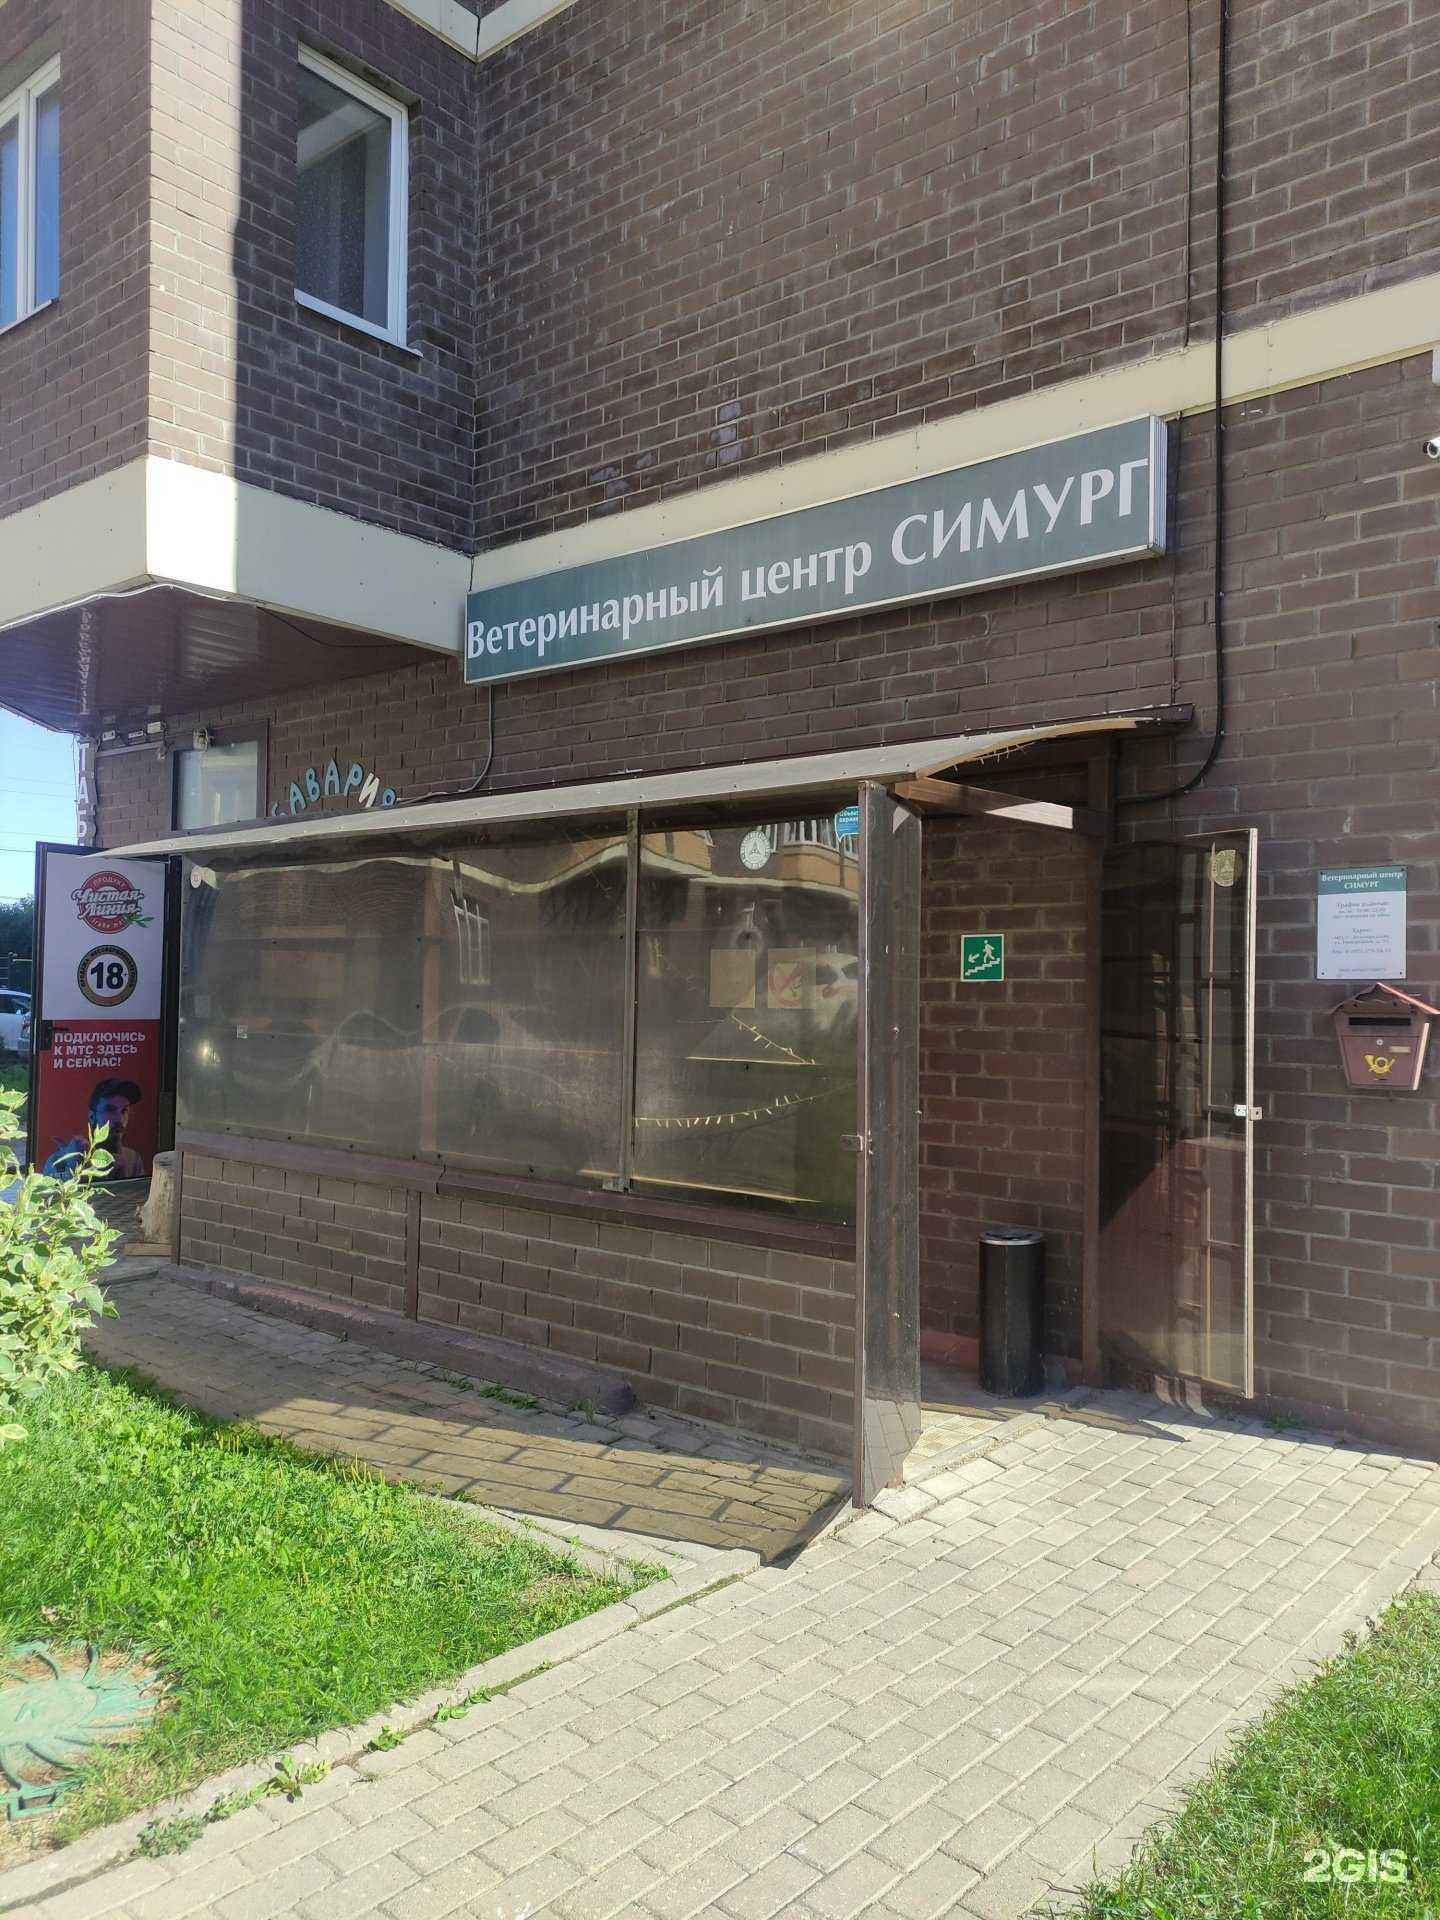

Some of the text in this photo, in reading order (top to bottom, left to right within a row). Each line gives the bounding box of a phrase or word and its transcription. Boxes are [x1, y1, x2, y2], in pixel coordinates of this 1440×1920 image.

[467, 457, 1149, 659] Ветеринарный центр СИМУРГ
[54, 1031, 146, 1045] ПОДКЛЮЧИСЬ
[54, 1044, 138, 1057] К МТС ЗДЕСЬ
[53, 1055, 122, 1069] И СЕЙЧАС!
